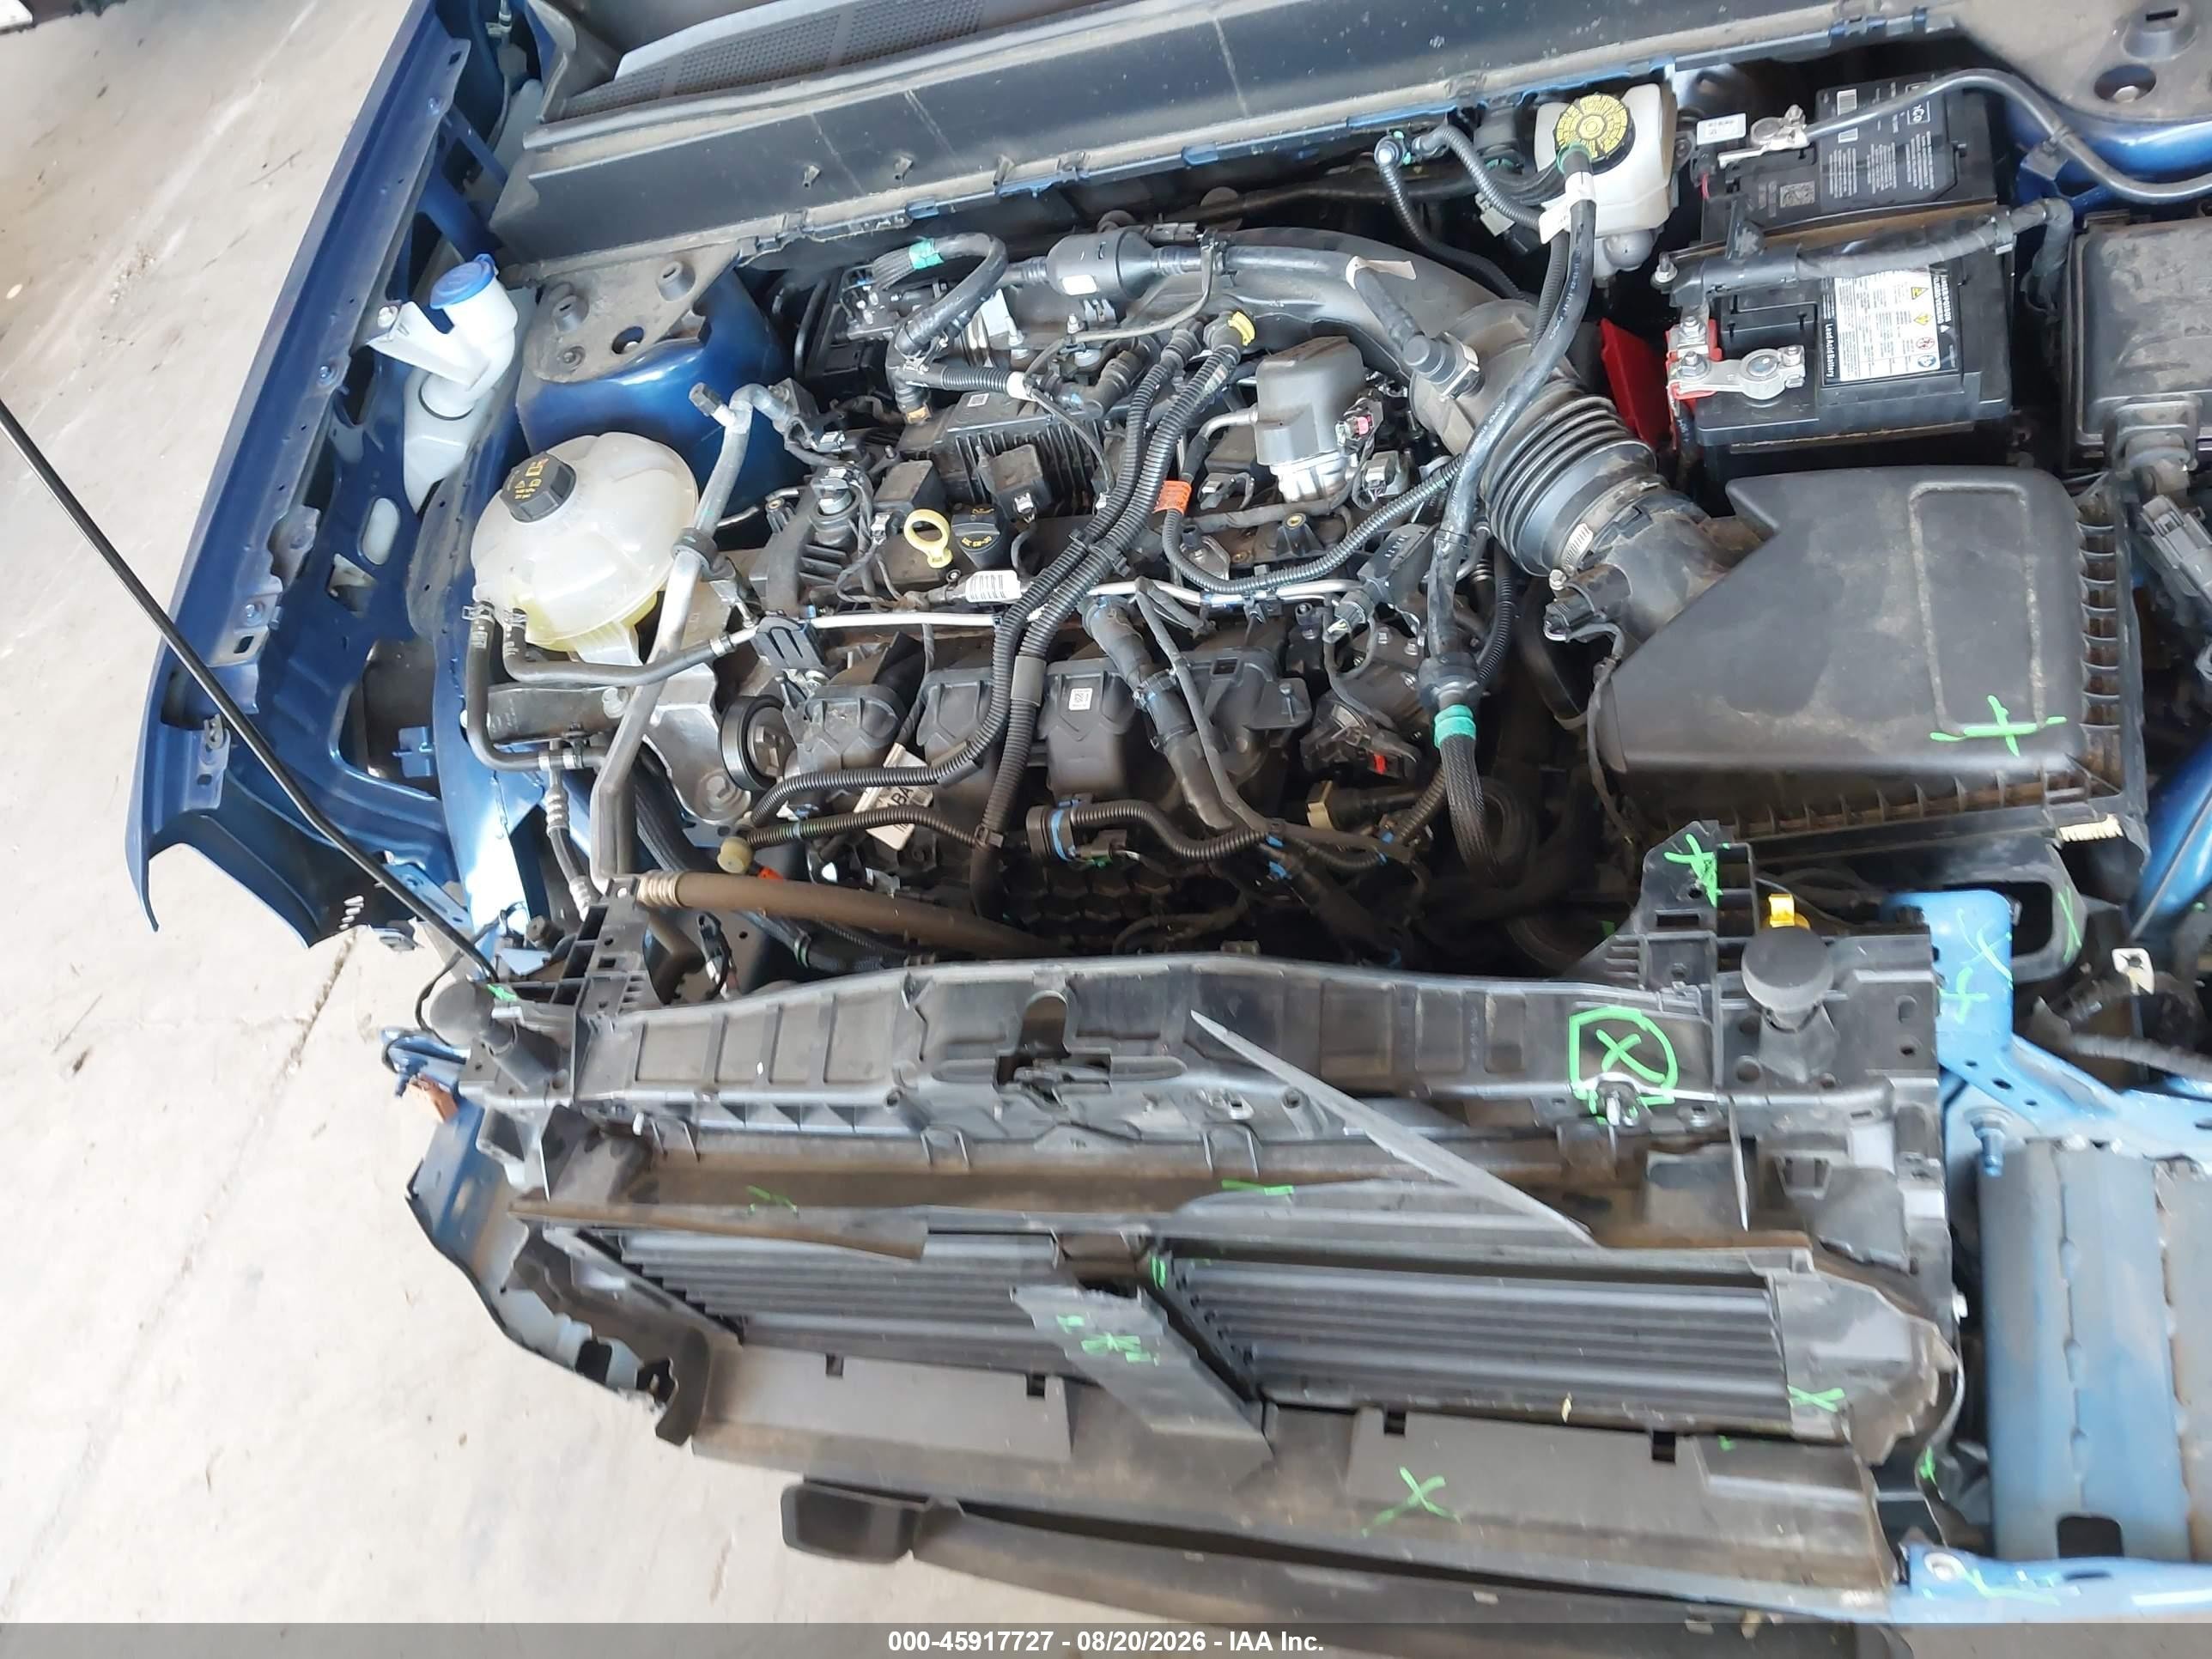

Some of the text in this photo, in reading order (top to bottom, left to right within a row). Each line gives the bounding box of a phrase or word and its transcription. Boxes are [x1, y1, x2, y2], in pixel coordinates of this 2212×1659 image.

[1826, 324, 1834, 339] Lead
[1826, 339, 1835, 354] Acid
[1826, 355, 1836, 378] Battery
